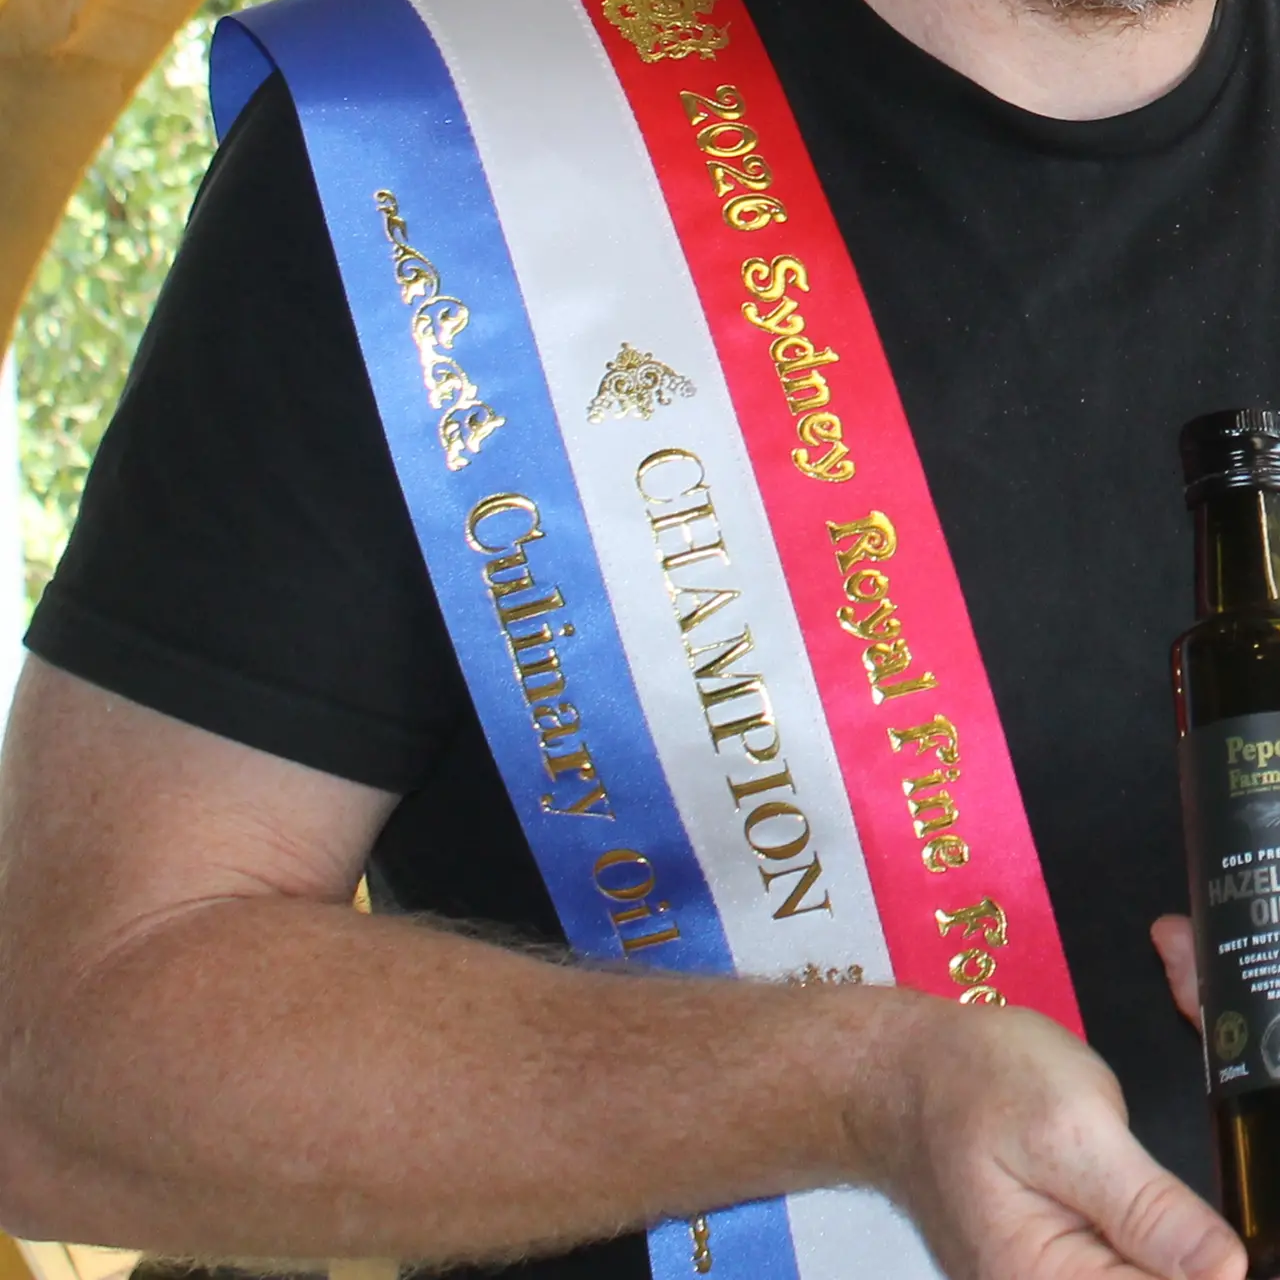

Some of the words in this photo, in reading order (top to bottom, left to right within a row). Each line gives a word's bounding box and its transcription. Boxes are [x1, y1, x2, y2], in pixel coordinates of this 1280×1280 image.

[680, 84, 786, 234] 2026
[741, 255, 855, 484] Sydney
[826, 510, 938, 704] Royal
[888, 714, 971, 873] Fine
[466, 493, 616, 820] Culinary
[592, 848, 680, 960] Oil
[635, 449, 834, 922] CHAMPION
[1218, 937, 1248, 955] SWEET
[1222, 851, 1252, 868] COLD
[1239, 949, 1280, 965] LOCALLY
